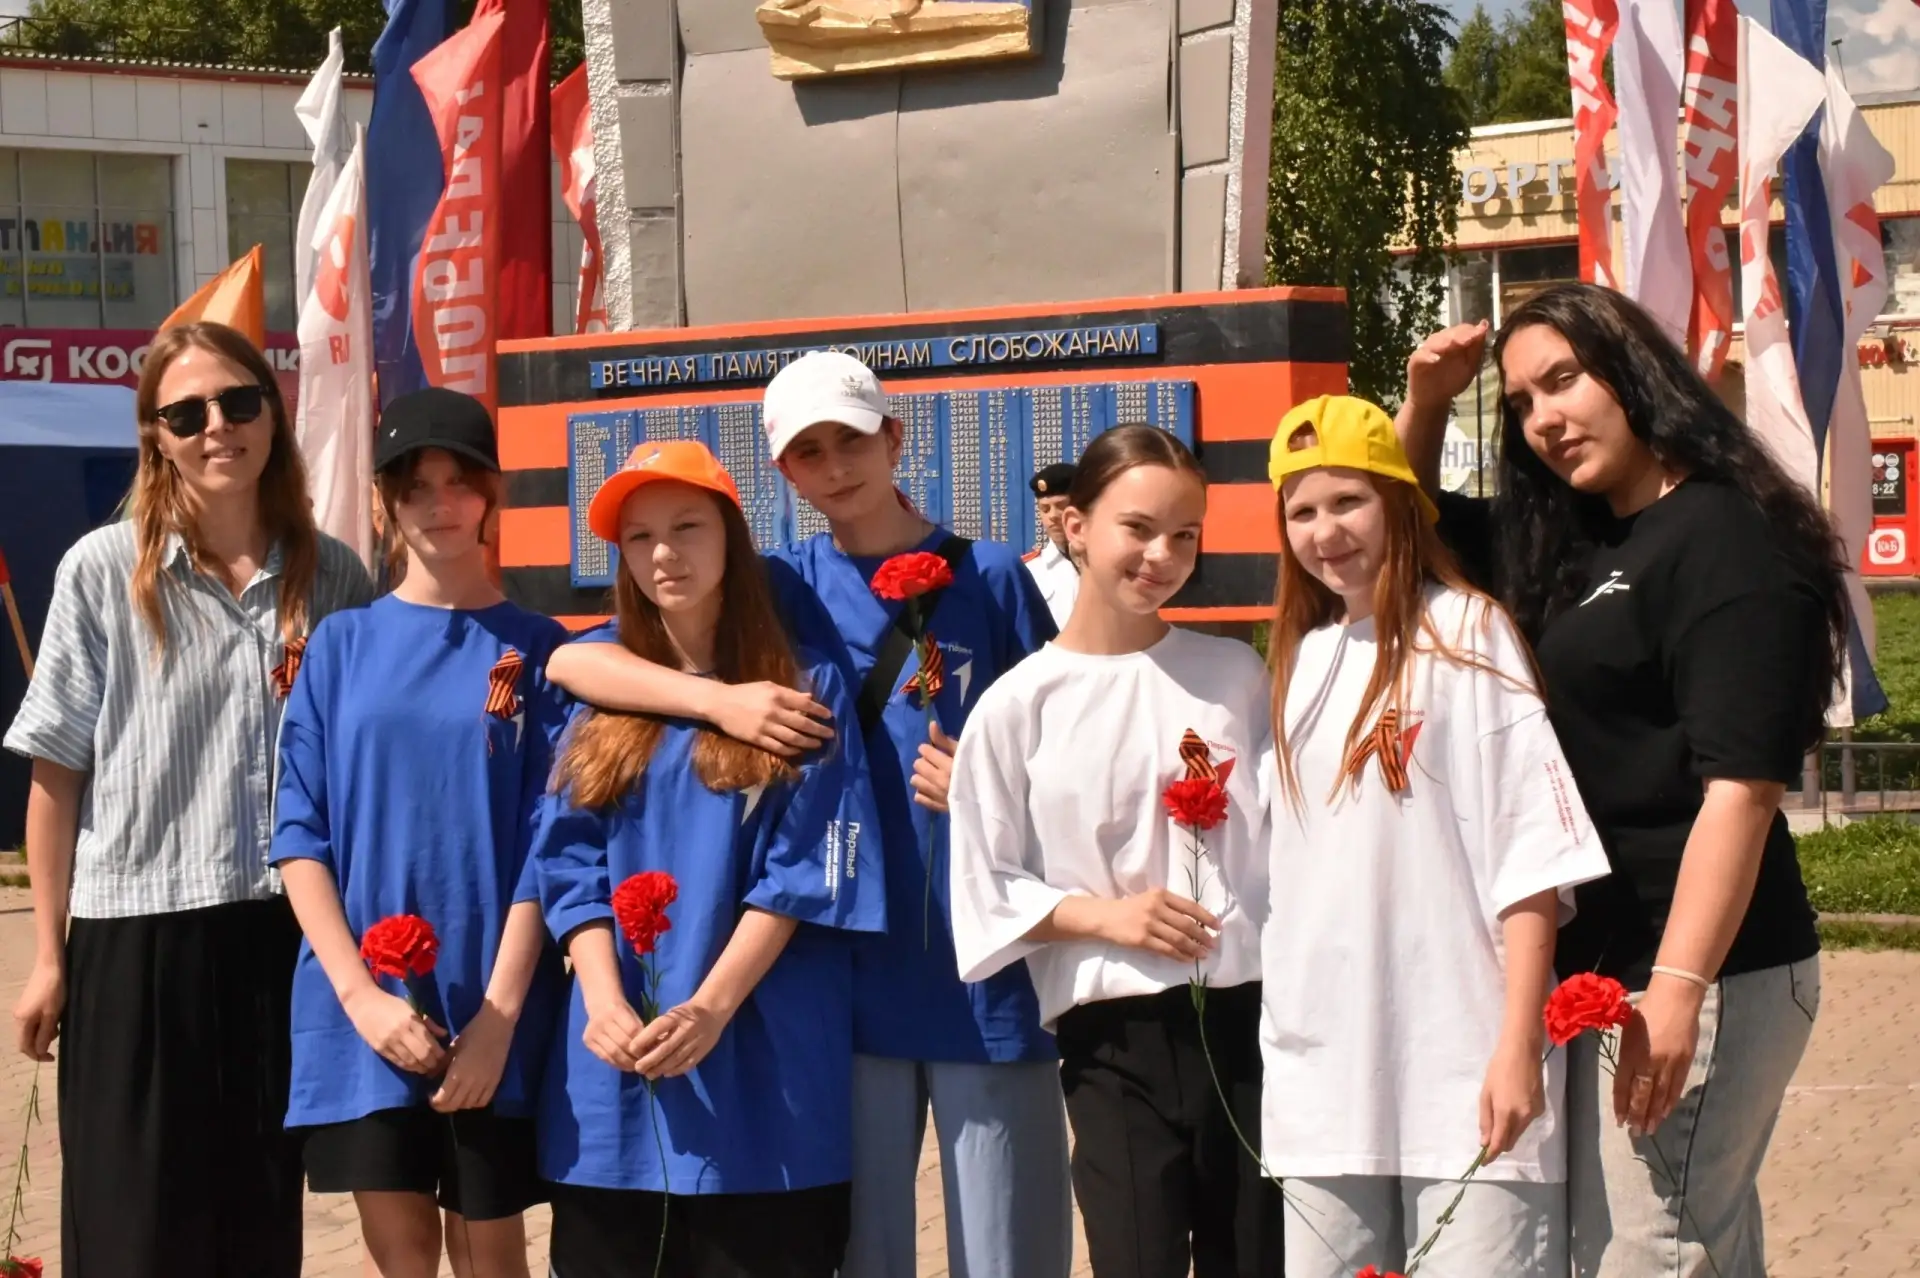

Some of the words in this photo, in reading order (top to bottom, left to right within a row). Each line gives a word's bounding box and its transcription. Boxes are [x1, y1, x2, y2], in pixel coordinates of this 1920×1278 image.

[602, 355, 695, 386] ВЕЧНАЯ
[711, 349, 806, 377] ПАМЯТ
[829, 342, 931, 368] ОИНАМ
[948, 327, 1140, 363] СЛОБОЖАНАМ
[1443, 441, 1493, 470] НДА
[846, 821, 861, 878] Первые
